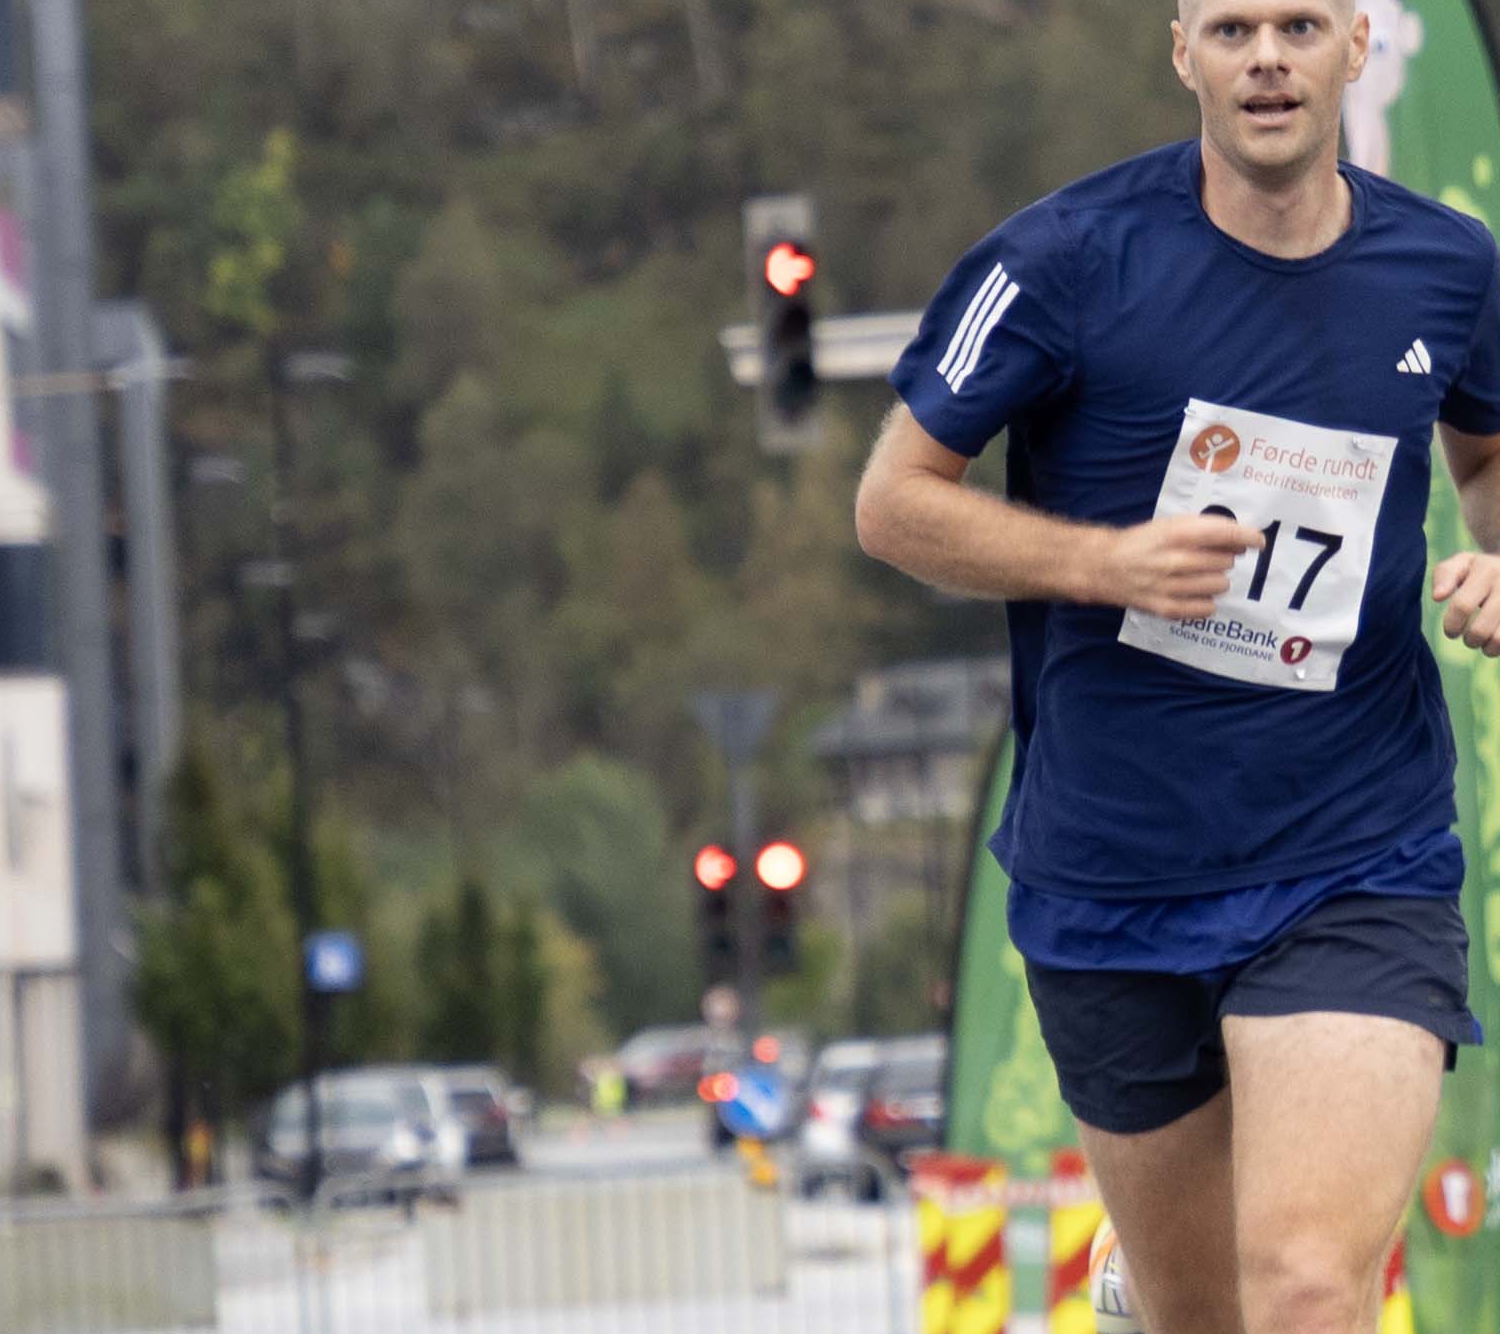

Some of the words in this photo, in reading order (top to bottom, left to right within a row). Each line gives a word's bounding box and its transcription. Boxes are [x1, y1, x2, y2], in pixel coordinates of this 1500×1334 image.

[1250, 438, 1317, 472] Førde
[1323, 458, 1378, 480] rundt
[1243, 466, 1358, 500] Bedriftsidretten
[1200, 505, 1344, 611] 17
[1169, 626, 1199, 643] SOGN
[1201, 636, 1217, 648] OG
[1178, 618, 1279, 649] pareBank
